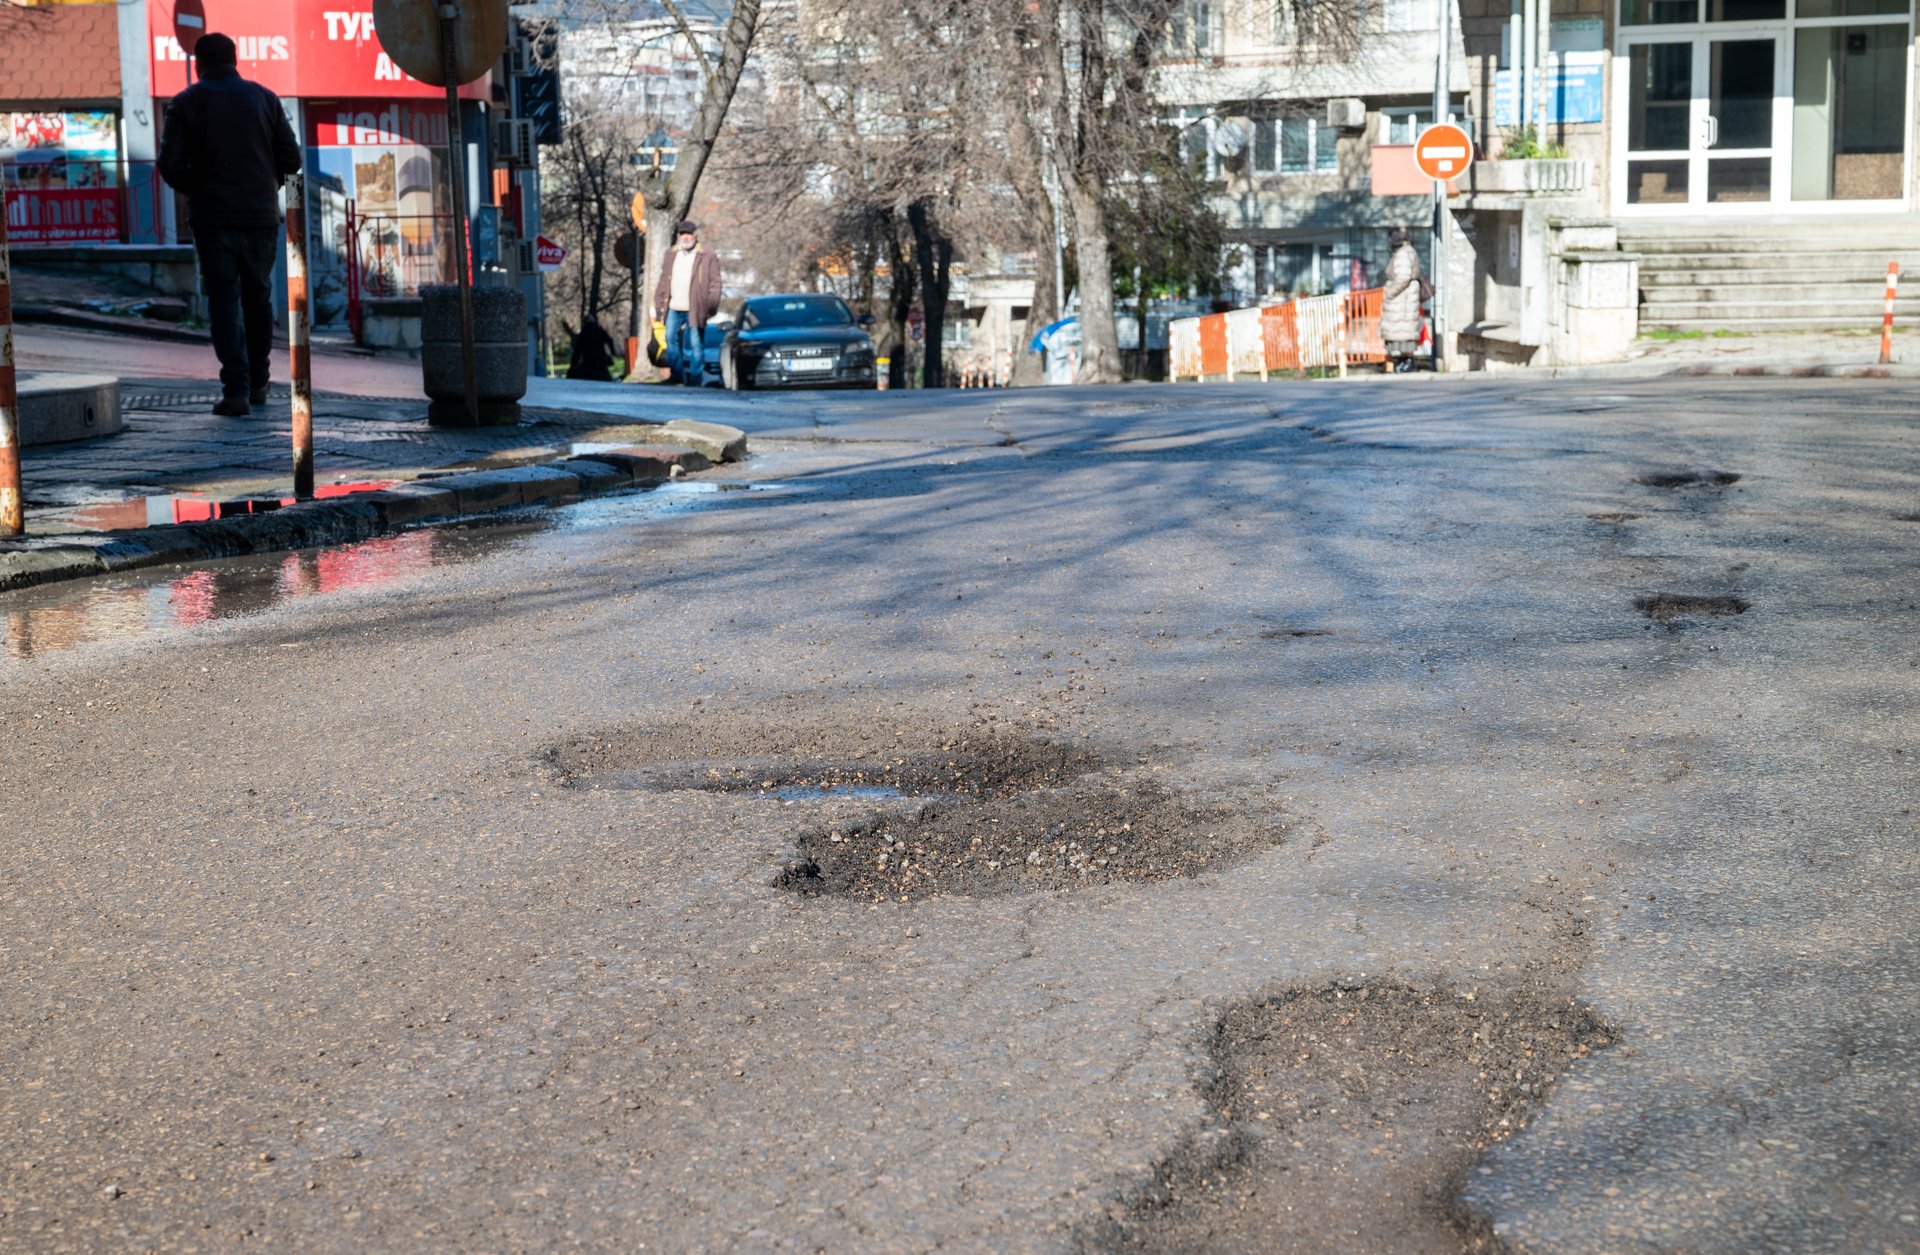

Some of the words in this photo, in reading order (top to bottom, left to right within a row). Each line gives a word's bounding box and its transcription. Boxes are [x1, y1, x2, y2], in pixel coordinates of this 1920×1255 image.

[323, 11, 376, 41] ТУР
[336, 103, 448, 145] redtou
[8, 193, 116, 226] dtours
